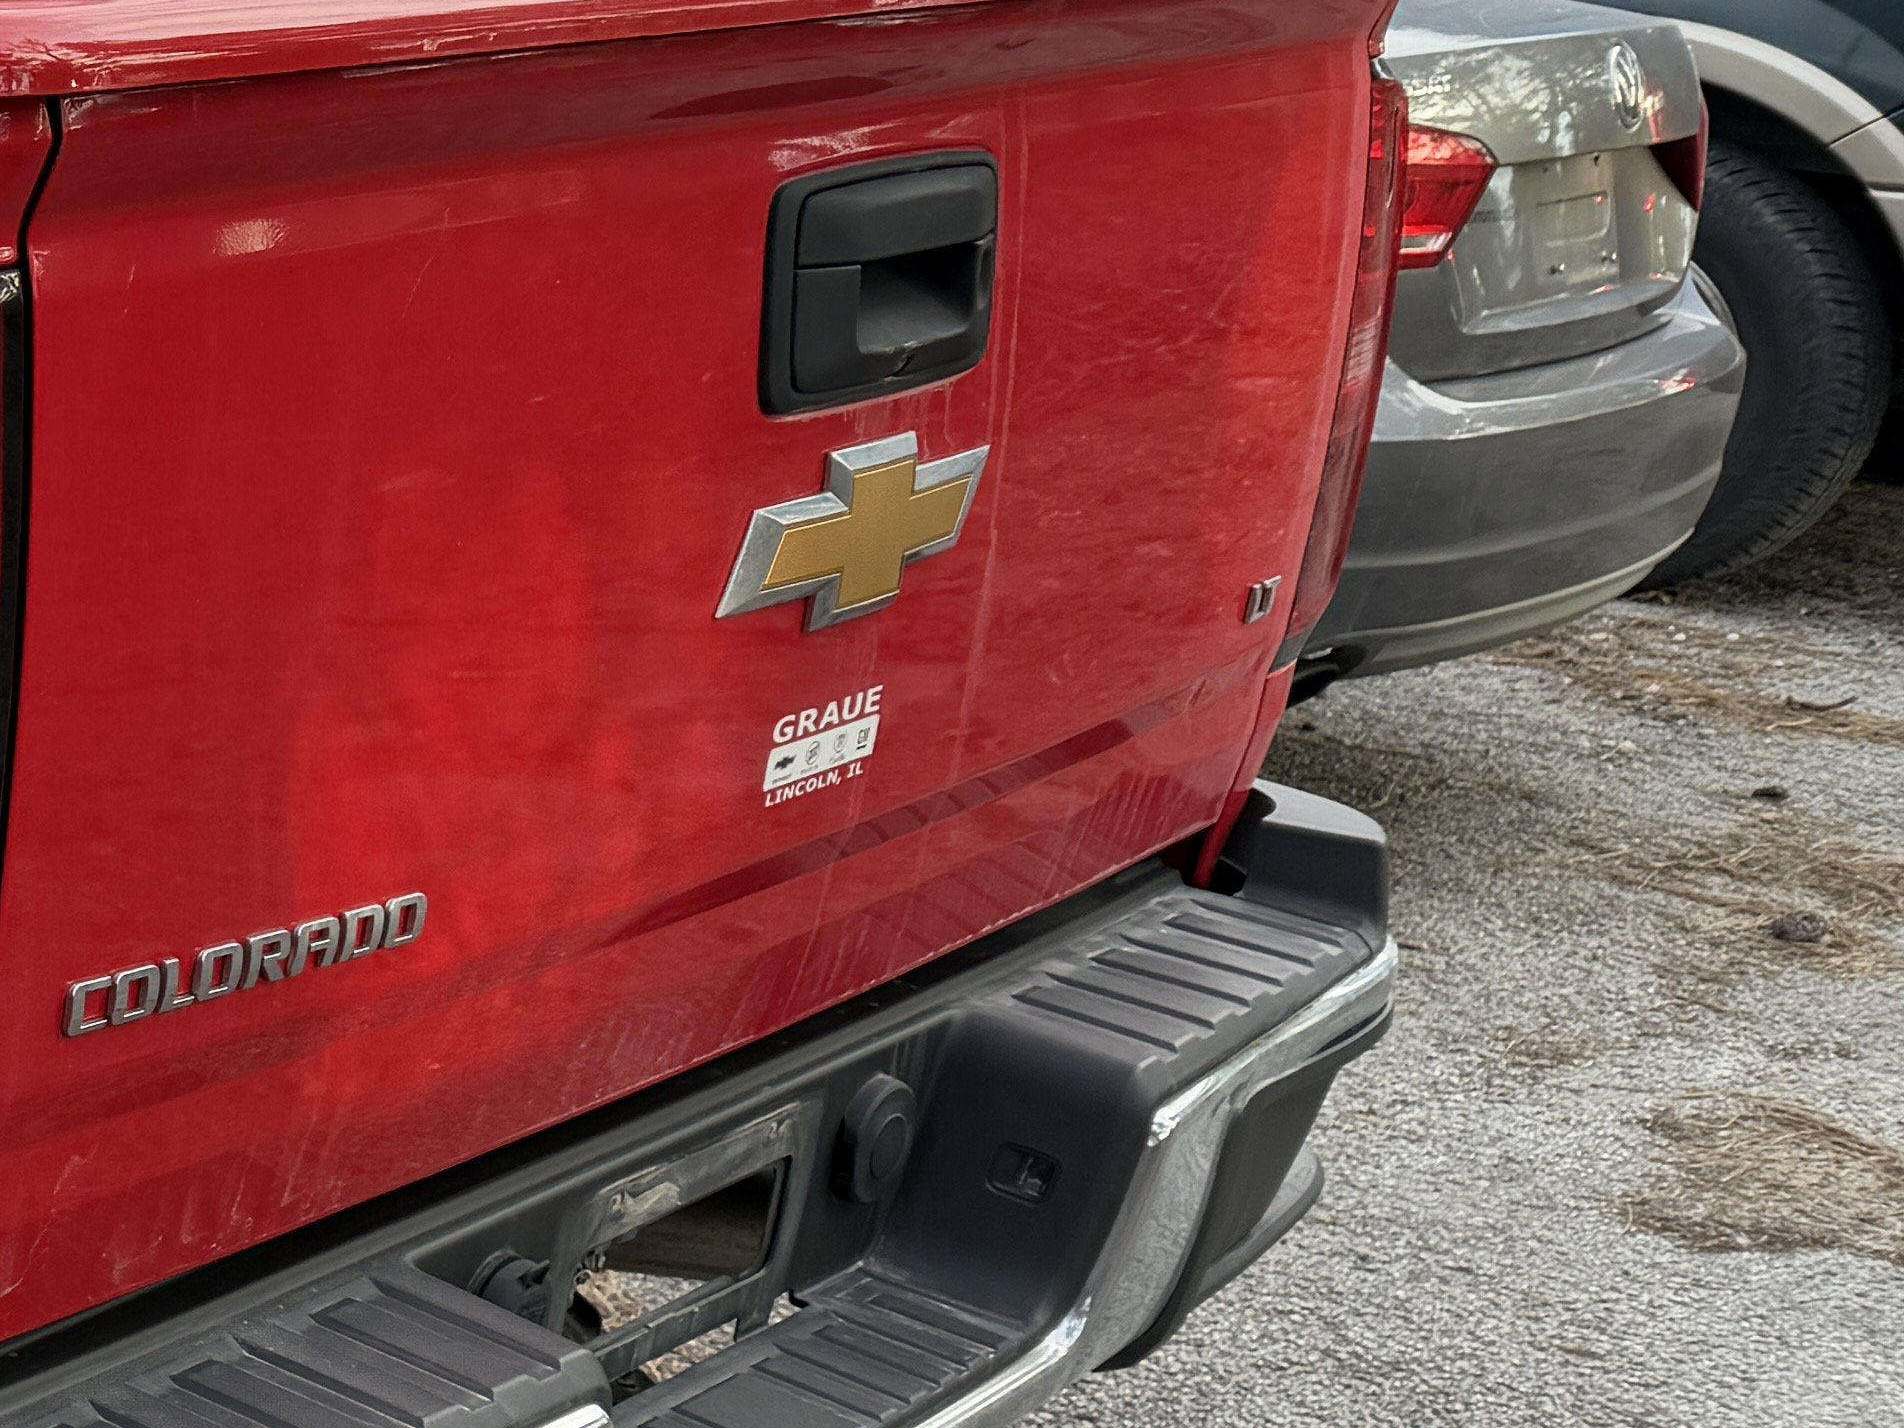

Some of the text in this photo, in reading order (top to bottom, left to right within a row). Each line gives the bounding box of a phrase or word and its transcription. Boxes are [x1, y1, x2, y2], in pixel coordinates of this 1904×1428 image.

[1242, 574, 1282, 625] LT
[772, 684, 884, 744] GRAUE
[764, 769, 842, 808] LINCOLN,
[847, 760, 864, 779] IL
[61, 891, 429, 1038] COLORADO
